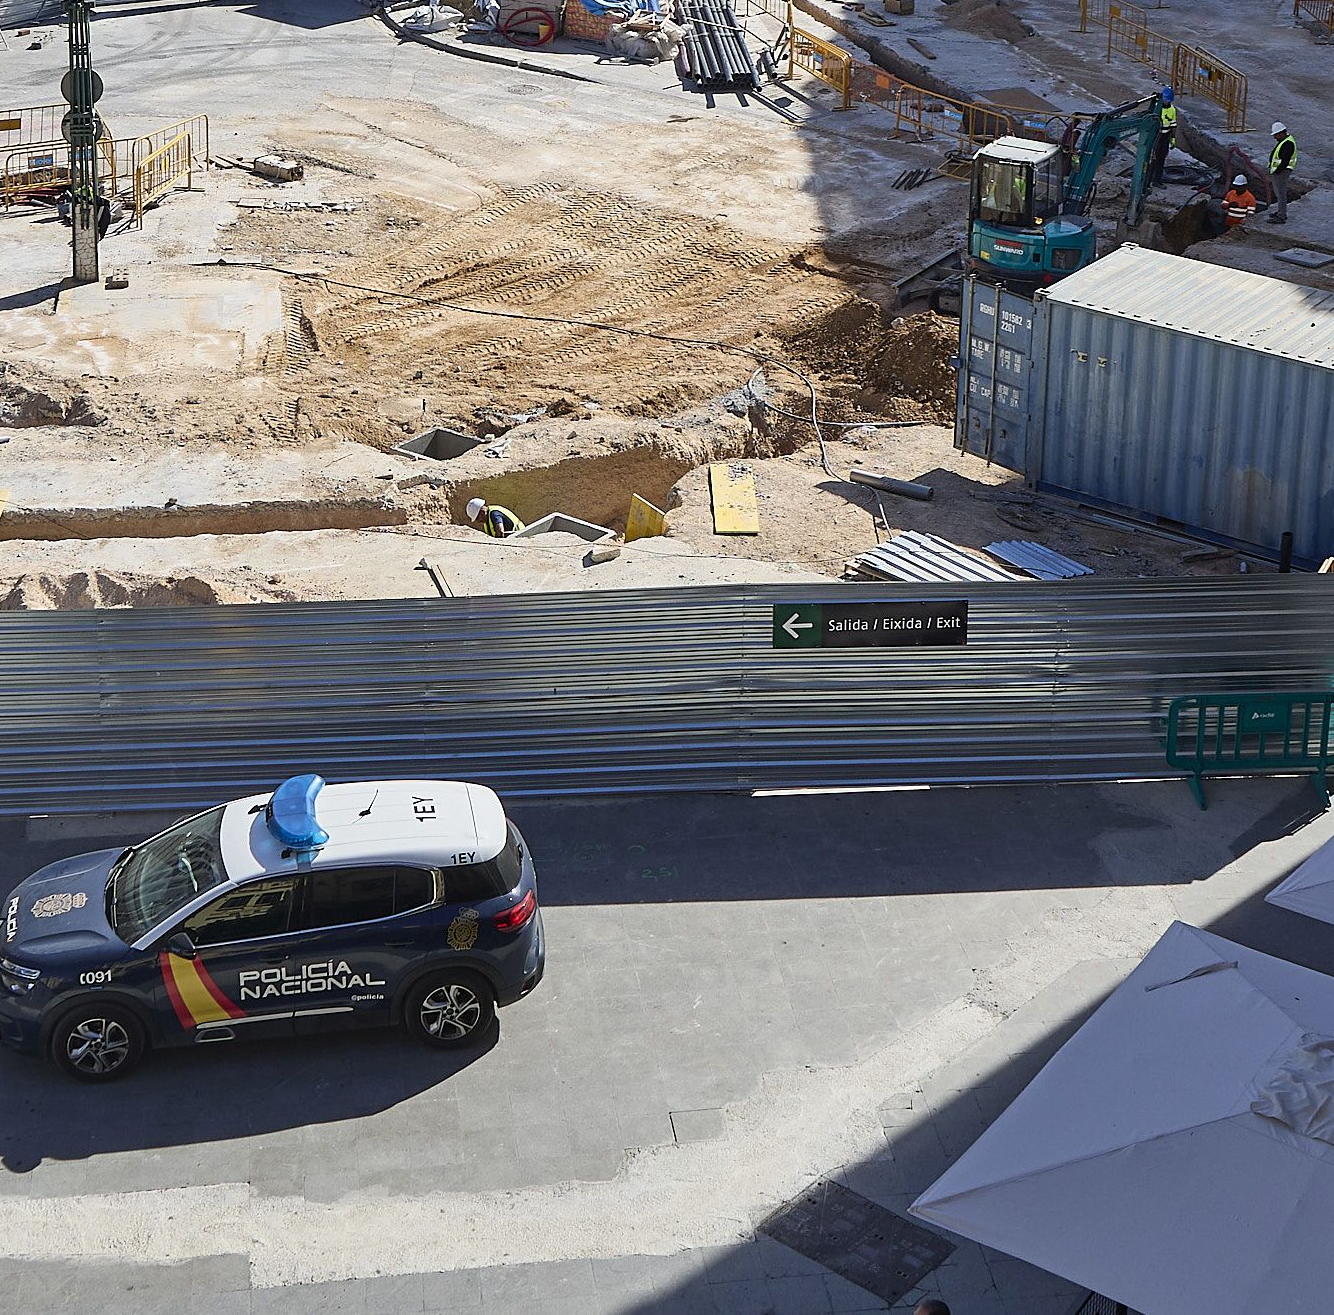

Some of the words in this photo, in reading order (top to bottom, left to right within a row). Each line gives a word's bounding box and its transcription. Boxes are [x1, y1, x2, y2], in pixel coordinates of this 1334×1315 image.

[994, 245, 1024, 255] SUNWARD
[828, 619, 868, 632] Salida
[873, 618, 878, 630] /
[883, 617, 922, 630] Eixida
[927, 617, 932, 629] /
[936, 616, 961, 629] Exit
[412, 796, 436, 822] 1EY
[451, 852, 475, 864] 1EY
[239, 958, 352, 986] POLICÍA
[240, 973, 385, 1001] NACIONAL
